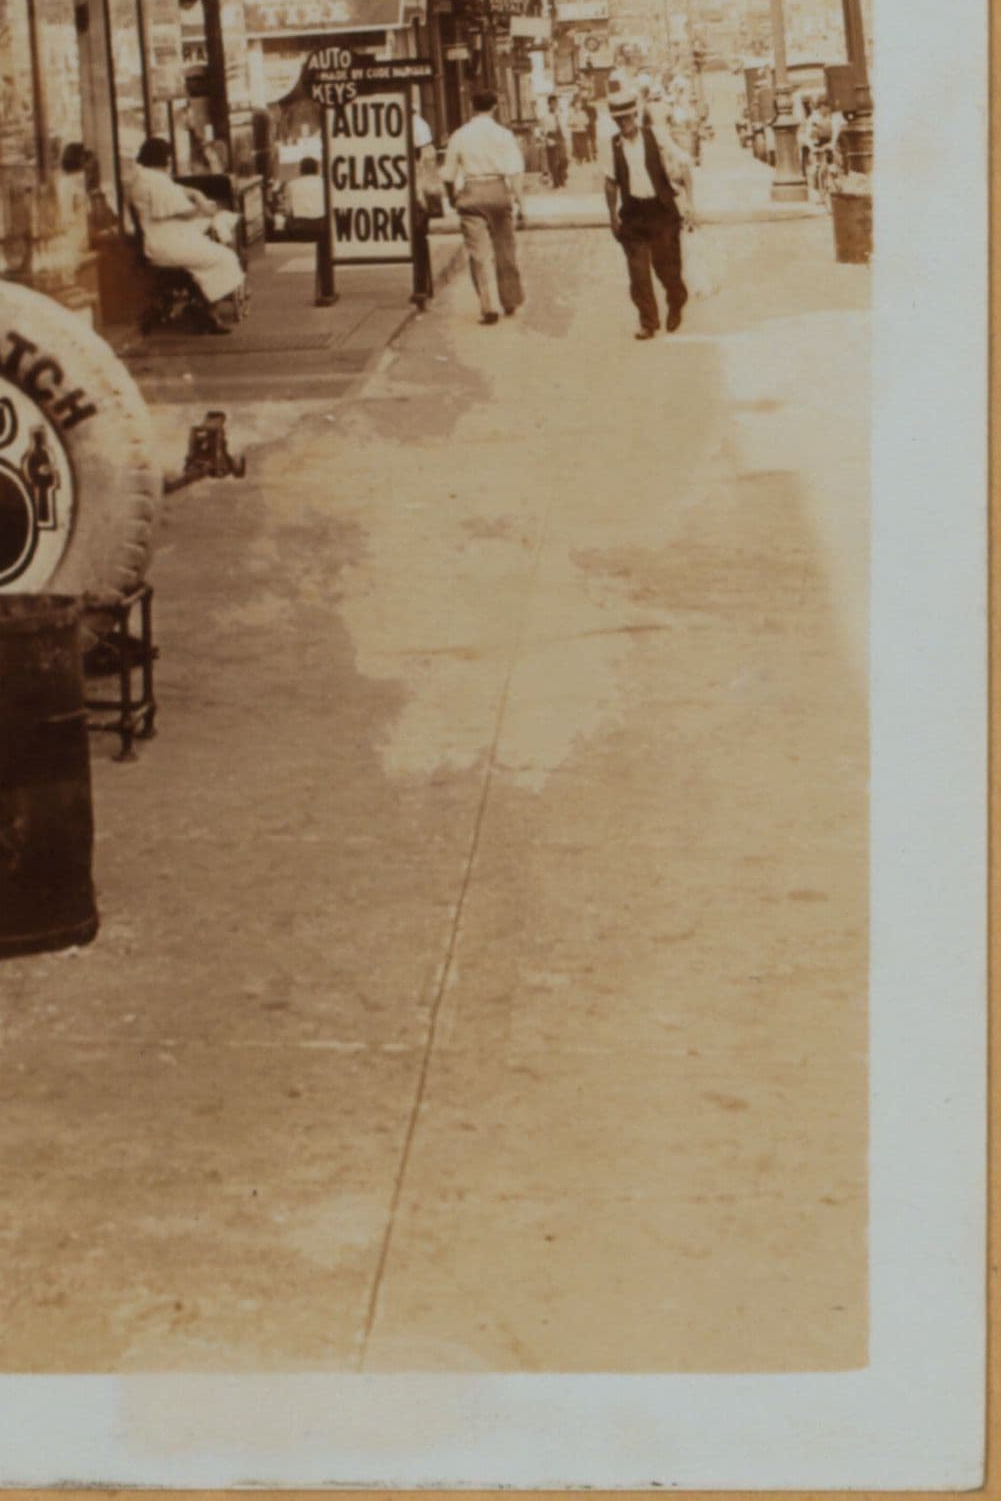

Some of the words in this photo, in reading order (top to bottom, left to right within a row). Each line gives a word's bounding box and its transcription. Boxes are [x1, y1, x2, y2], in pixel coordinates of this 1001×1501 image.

[308, 47, 352, 70] AUTO
[311, 82, 358, 105] KEYS
[331, 102, 402, 139] AUTO
[331, 154, 408, 192] GLASS
[333, 205, 409, 243] WORK
